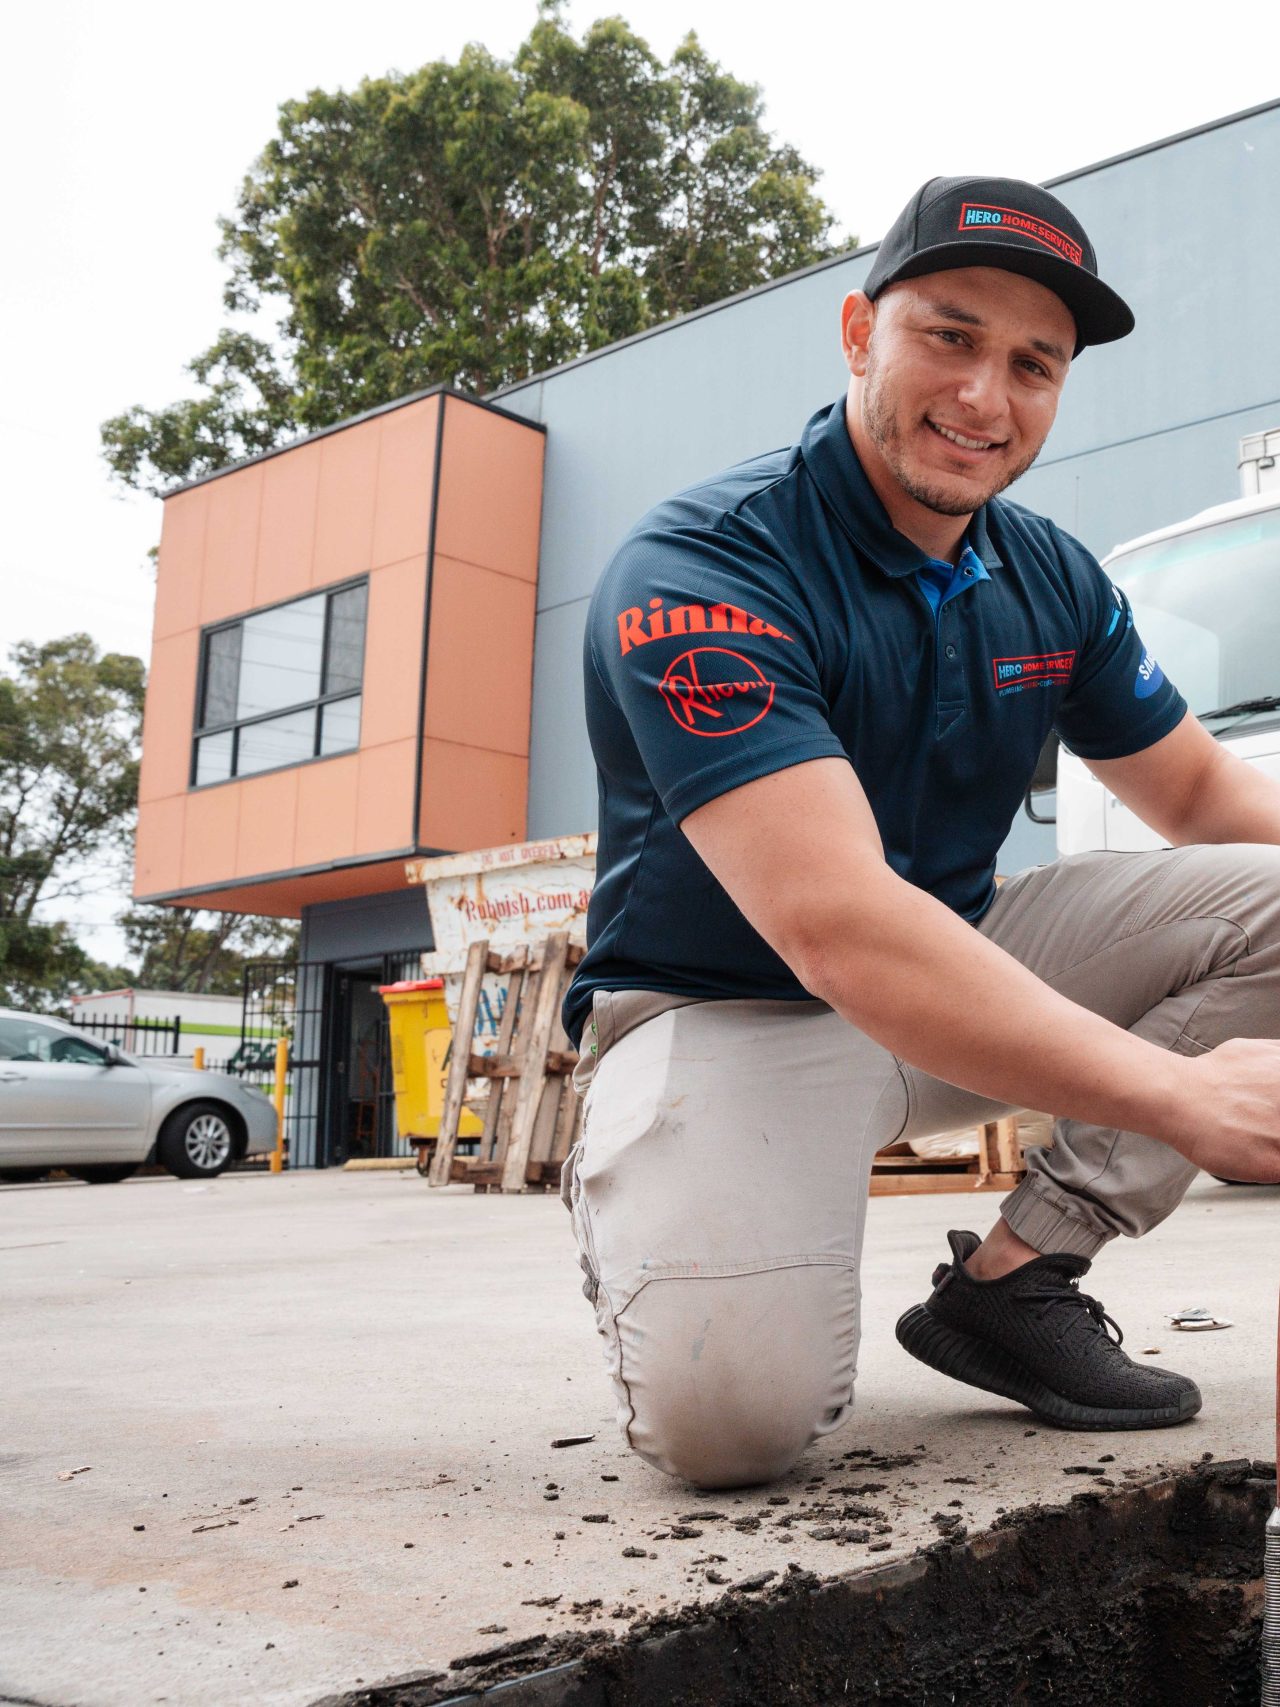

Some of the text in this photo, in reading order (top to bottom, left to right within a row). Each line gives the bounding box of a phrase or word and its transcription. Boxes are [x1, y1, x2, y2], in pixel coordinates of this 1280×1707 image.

[965, 209, 1080, 265] HERO HOME SERVICES
[617, 597, 795, 657] Rinna
[998, 663, 1023, 679] HERO
[1023, 661, 1045, 673] HOME
[482, 853, 494, 866] DO
[500, 849, 516, 863] NOT
